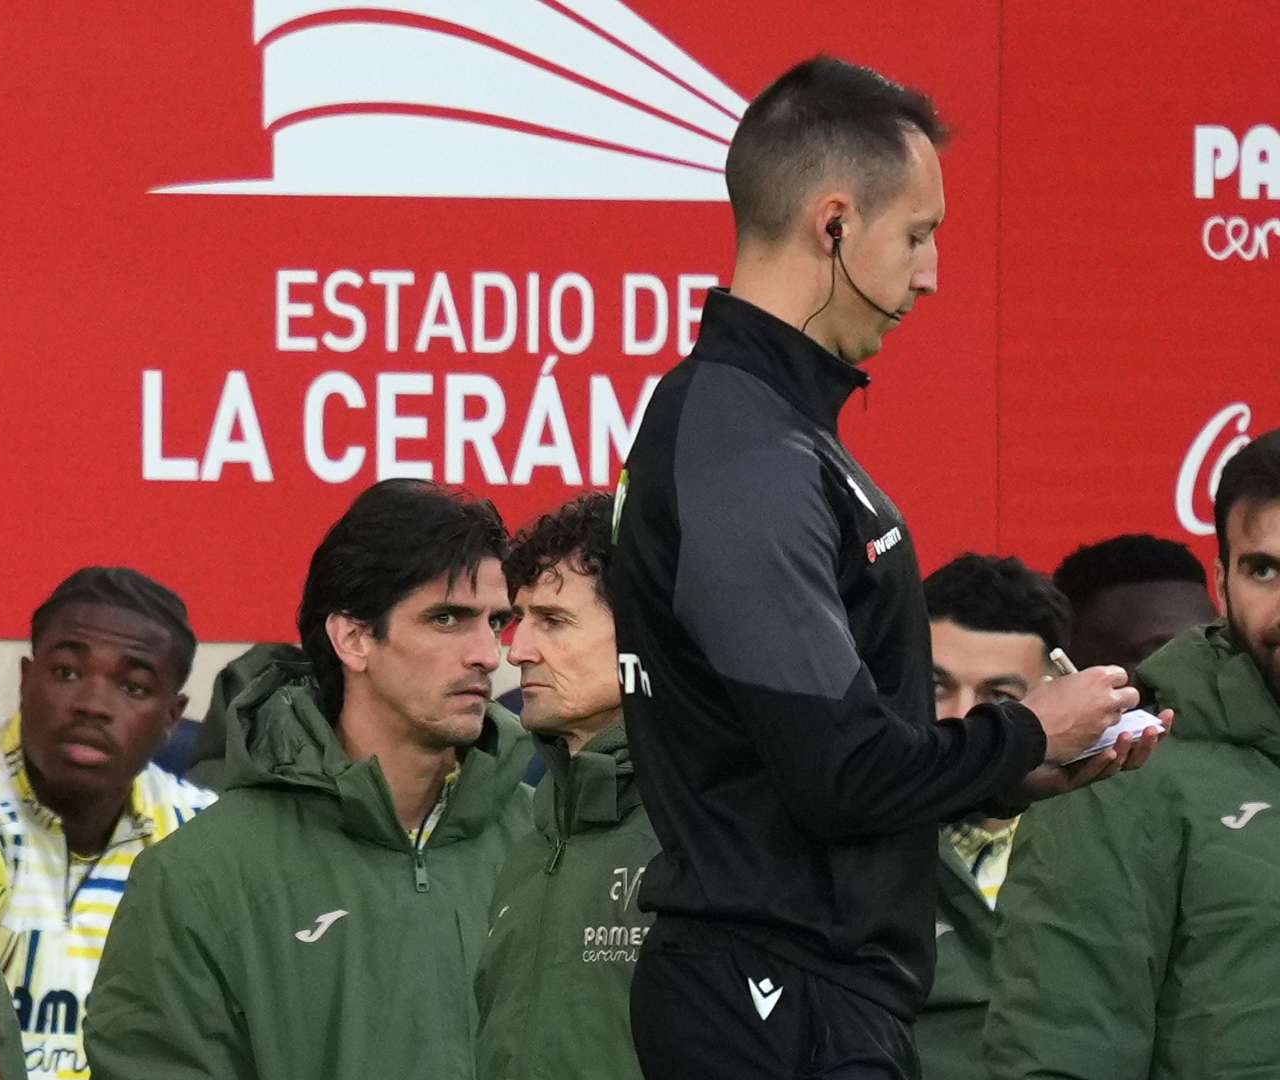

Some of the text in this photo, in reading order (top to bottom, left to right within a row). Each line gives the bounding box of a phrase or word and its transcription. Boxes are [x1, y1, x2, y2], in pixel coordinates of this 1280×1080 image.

[275, 270, 720, 356] ESTADIO DE
[142, 369, 274, 483] LA
